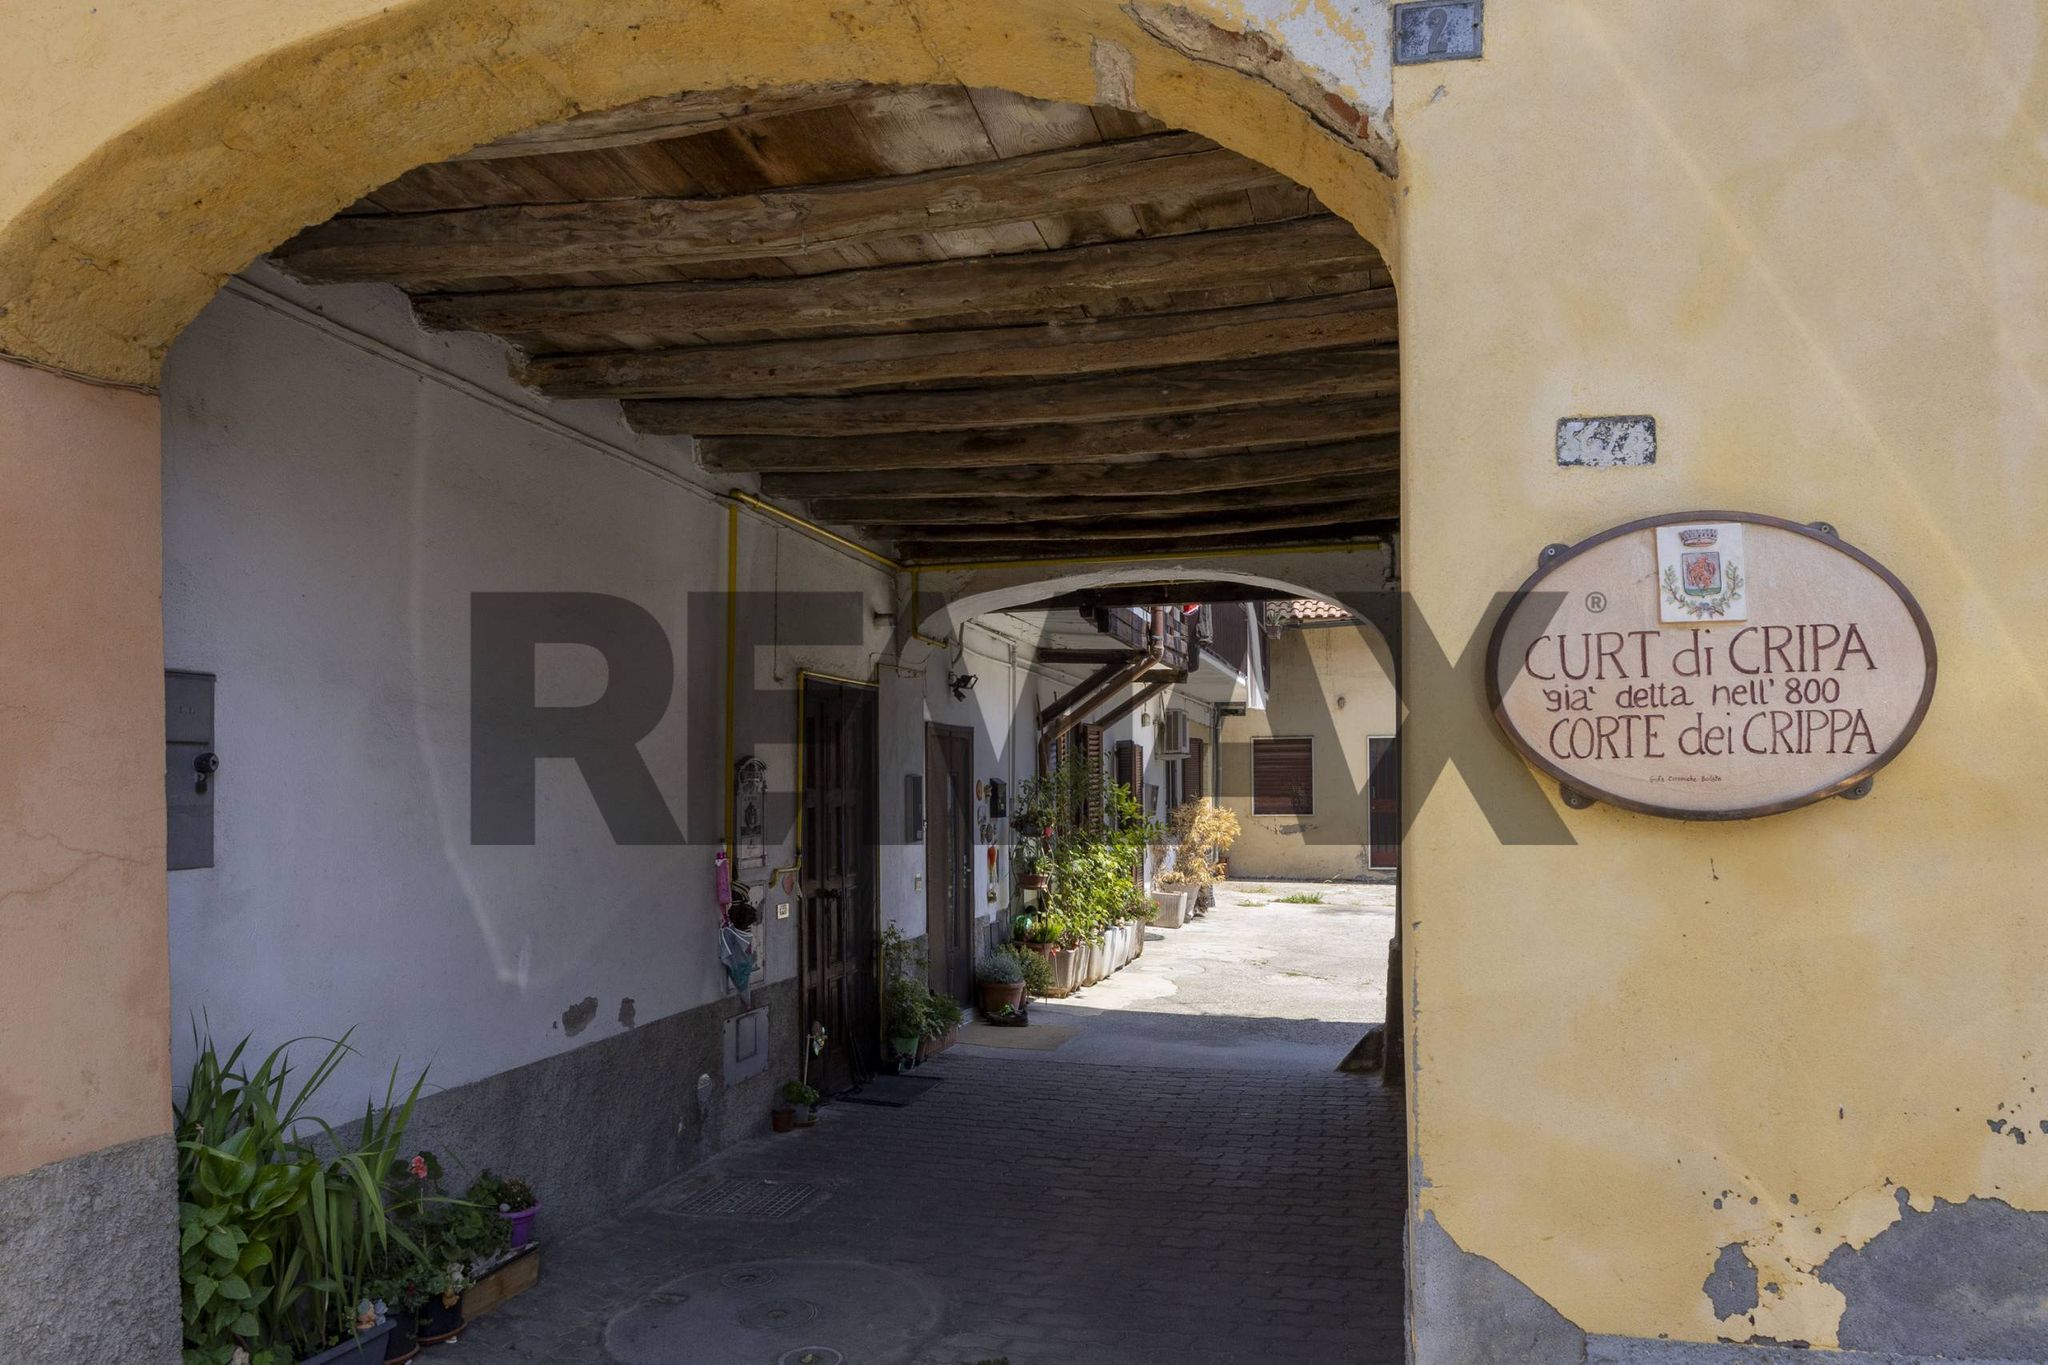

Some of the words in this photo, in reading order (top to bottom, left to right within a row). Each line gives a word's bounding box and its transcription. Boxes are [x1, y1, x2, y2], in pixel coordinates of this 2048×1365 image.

[1525, 630, 1660, 680] CURT
[1673, 629, 1714, 677] di
[1729, 623, 1878, 675] CRIPA
[1615, 682, 1694, 709] detta
[1550, 714, 1665, 760] CORTE
[1678, 711, 1735, 756] dei
[1743, 709, 1880, 755] CRIPPA
